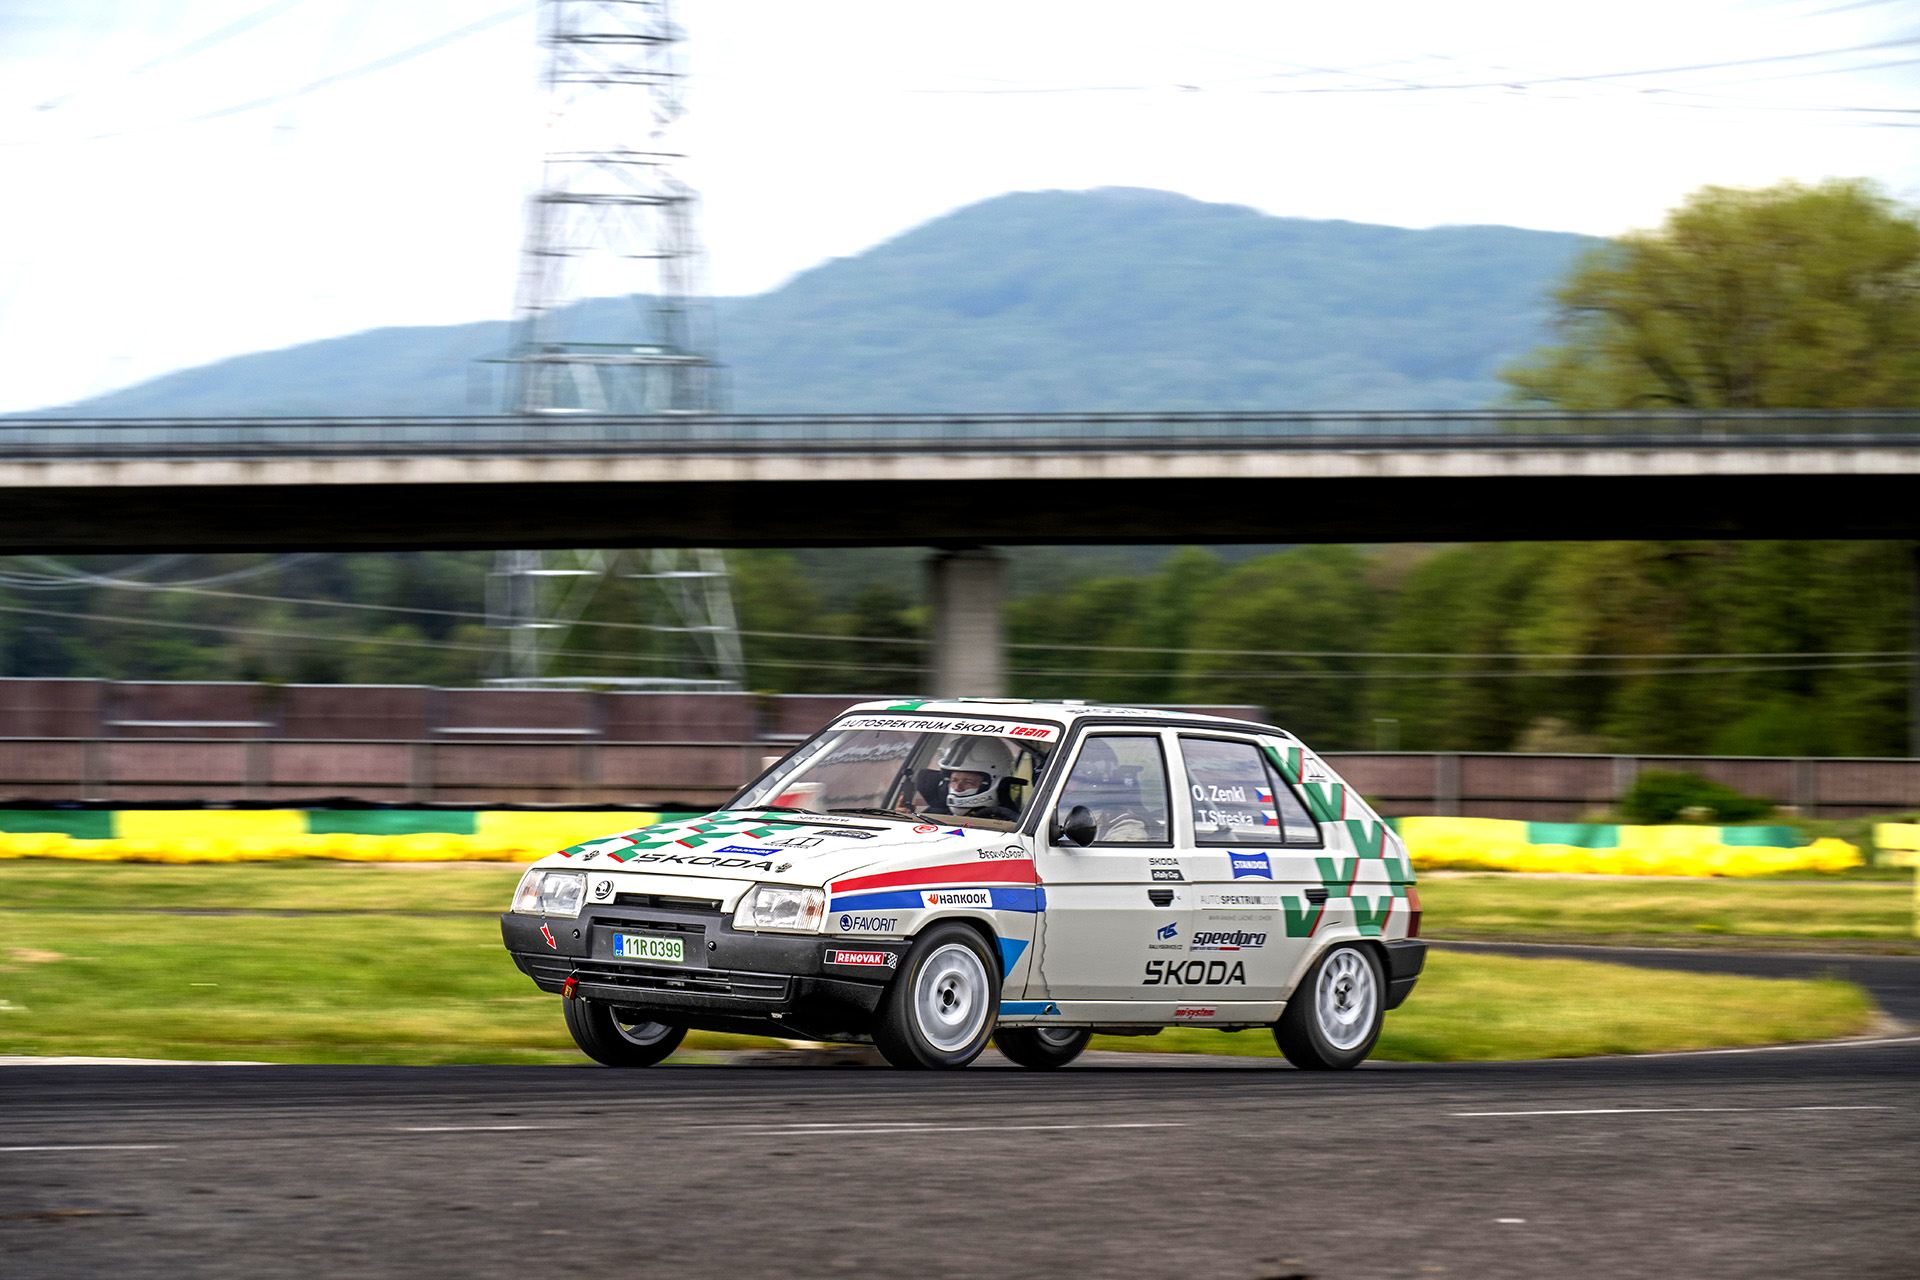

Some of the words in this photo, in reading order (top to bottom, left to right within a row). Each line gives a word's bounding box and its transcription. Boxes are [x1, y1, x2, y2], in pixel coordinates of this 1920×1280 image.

[841, 719, 950, 730] AUTOSPEKTRUM
[951, 721, 1004, 733] ŠKODA
[1009, 726, 1051, 738] team
[1192, 784, 1209, 802] O.
[1208, 785, 1247, 802] Zenkl
[853, 917, 898, 932] FAVORIT
[1192, 930, 1267, 946] speedpro
[625, 938, 648, 956] 11R
[649, 940, 681, 958] 0399
[836, 952, 882, 965] RENOVAK
